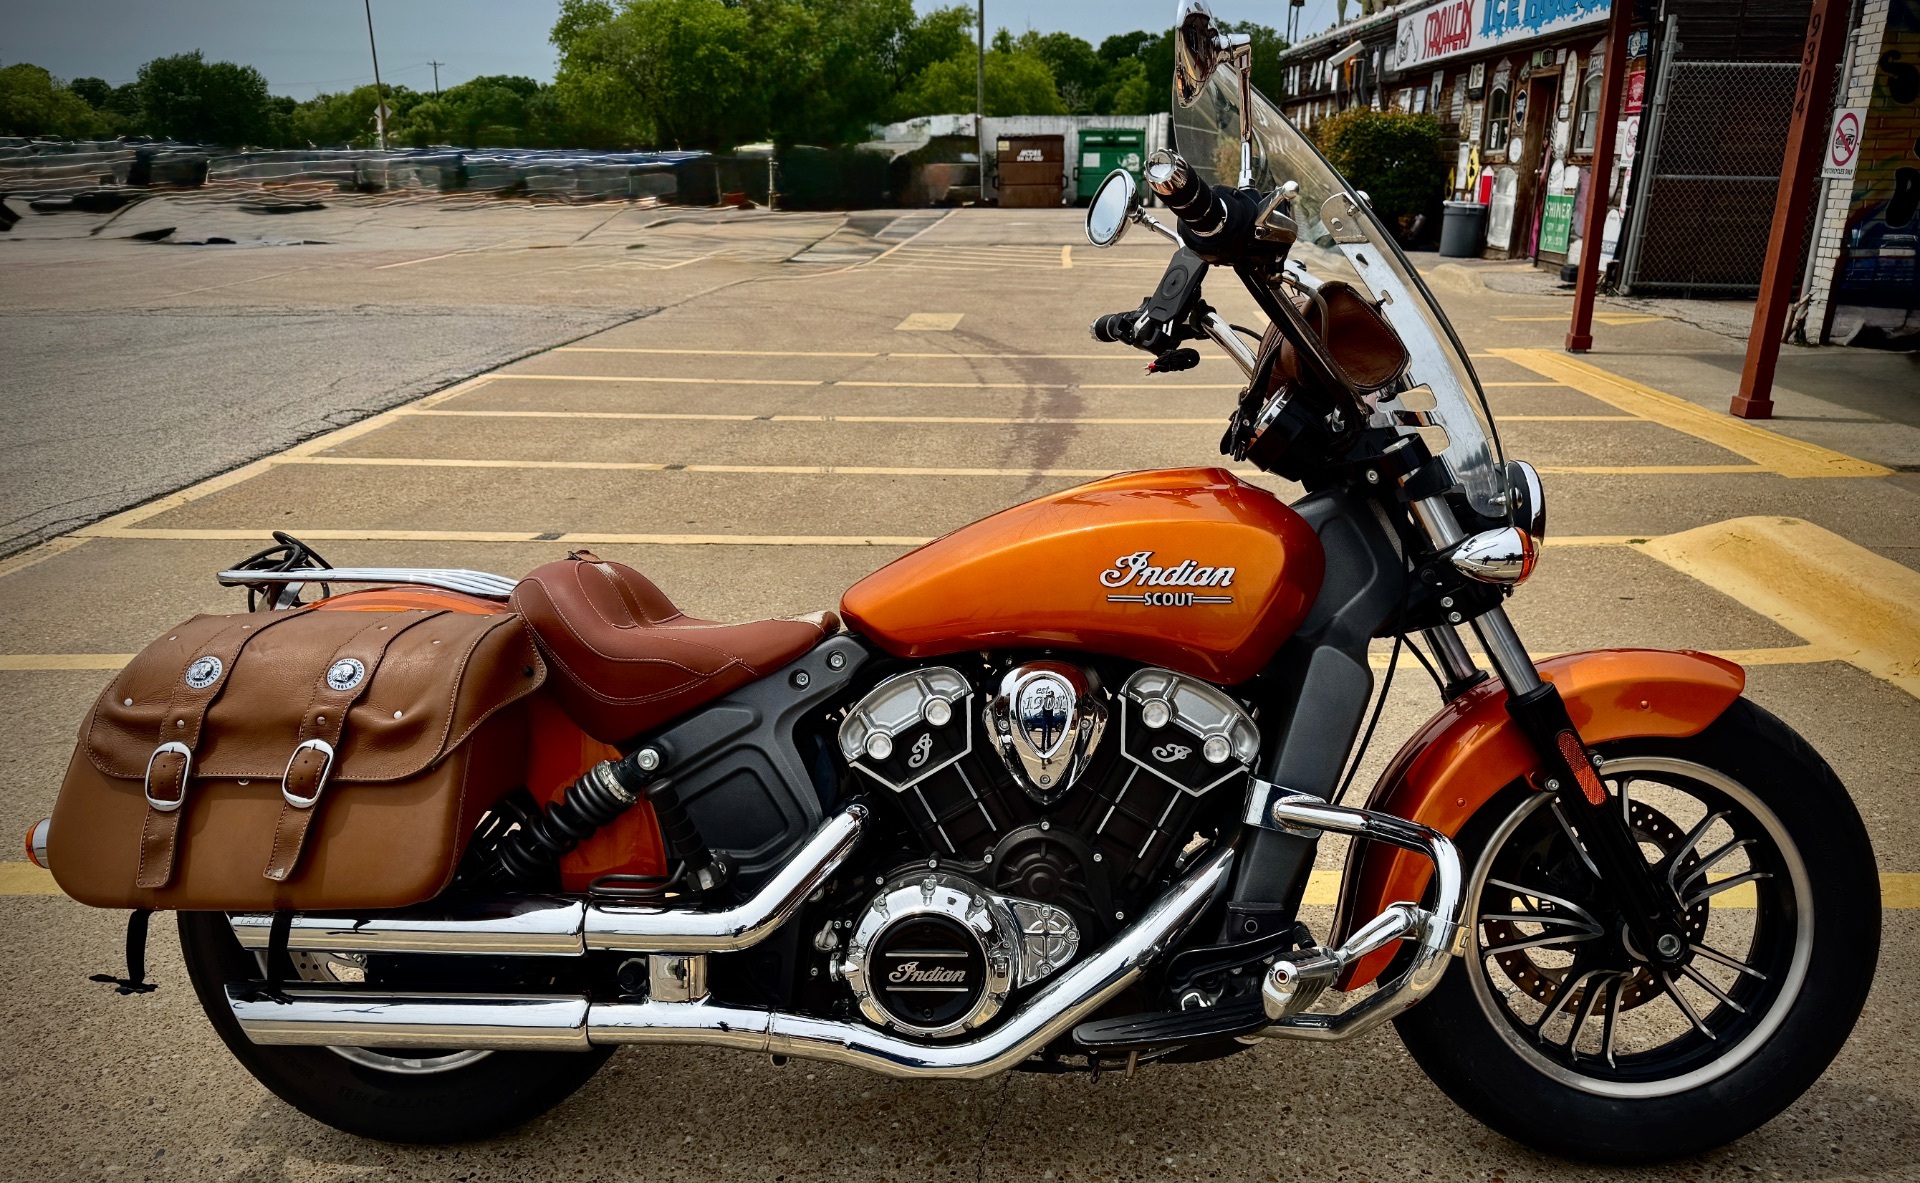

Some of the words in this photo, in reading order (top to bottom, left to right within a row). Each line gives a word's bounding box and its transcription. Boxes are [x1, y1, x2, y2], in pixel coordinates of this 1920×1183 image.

[1795, 13, 1821, 118] 9304
[1545, 201, 1571, 219] SHINER
[1100, 551, 1236, 588] Indian
[1144, 592, 1194, 606] SCOUT
[888, 961, 966, 983] Indian
